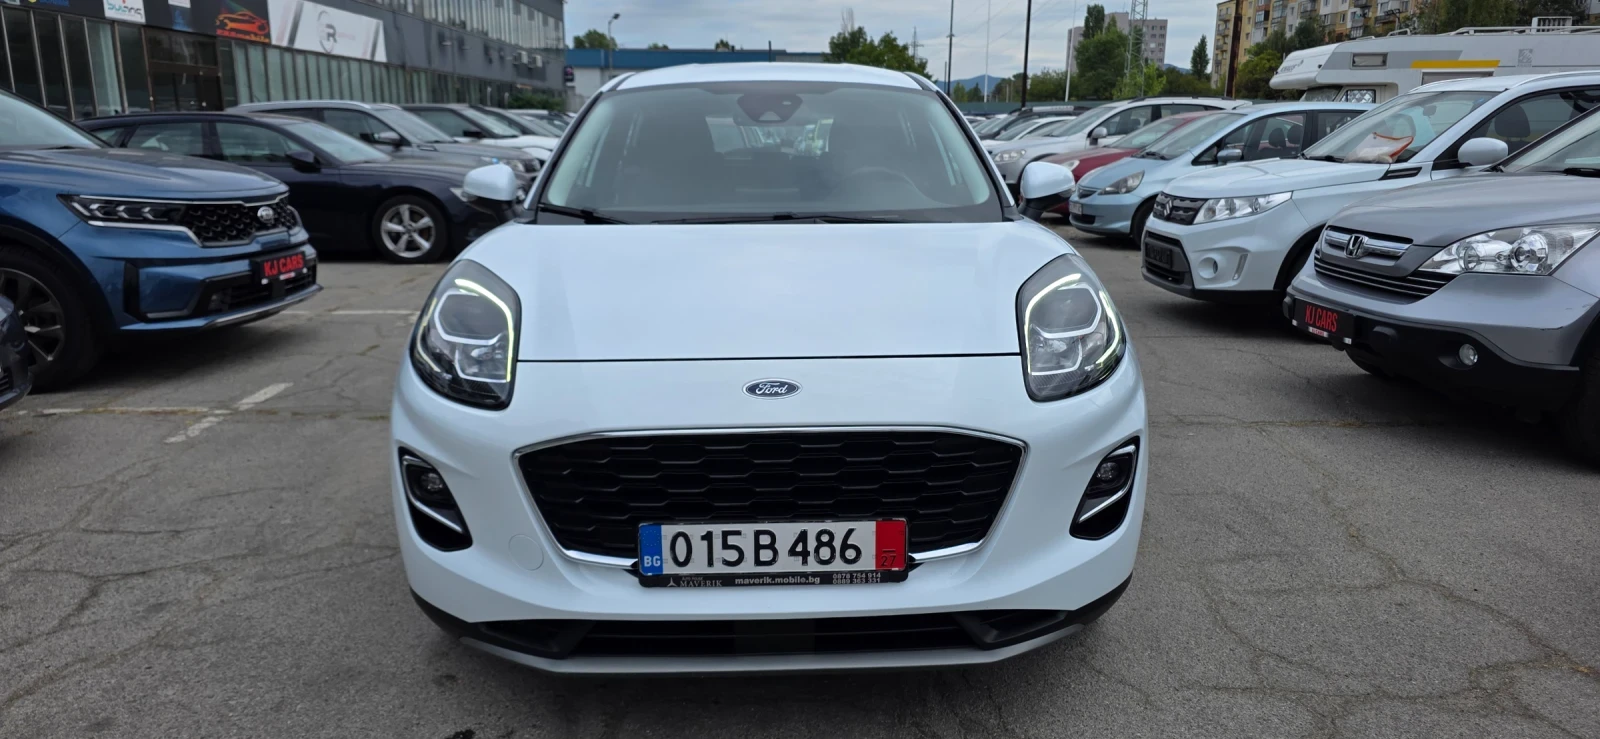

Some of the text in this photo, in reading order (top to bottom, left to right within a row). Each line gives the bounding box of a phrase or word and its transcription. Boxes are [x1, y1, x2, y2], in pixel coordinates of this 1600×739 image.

[264, 254, 304, 277] KJ CARS
[1305, 305, 1338, 332] KJ CARS
[755, 382, 788, 394] Ford
[643, 556, 661, 567] BG
[881, 555, 897, 567] 27
[735, 576, 820, 585] maverik.mobile.bg
